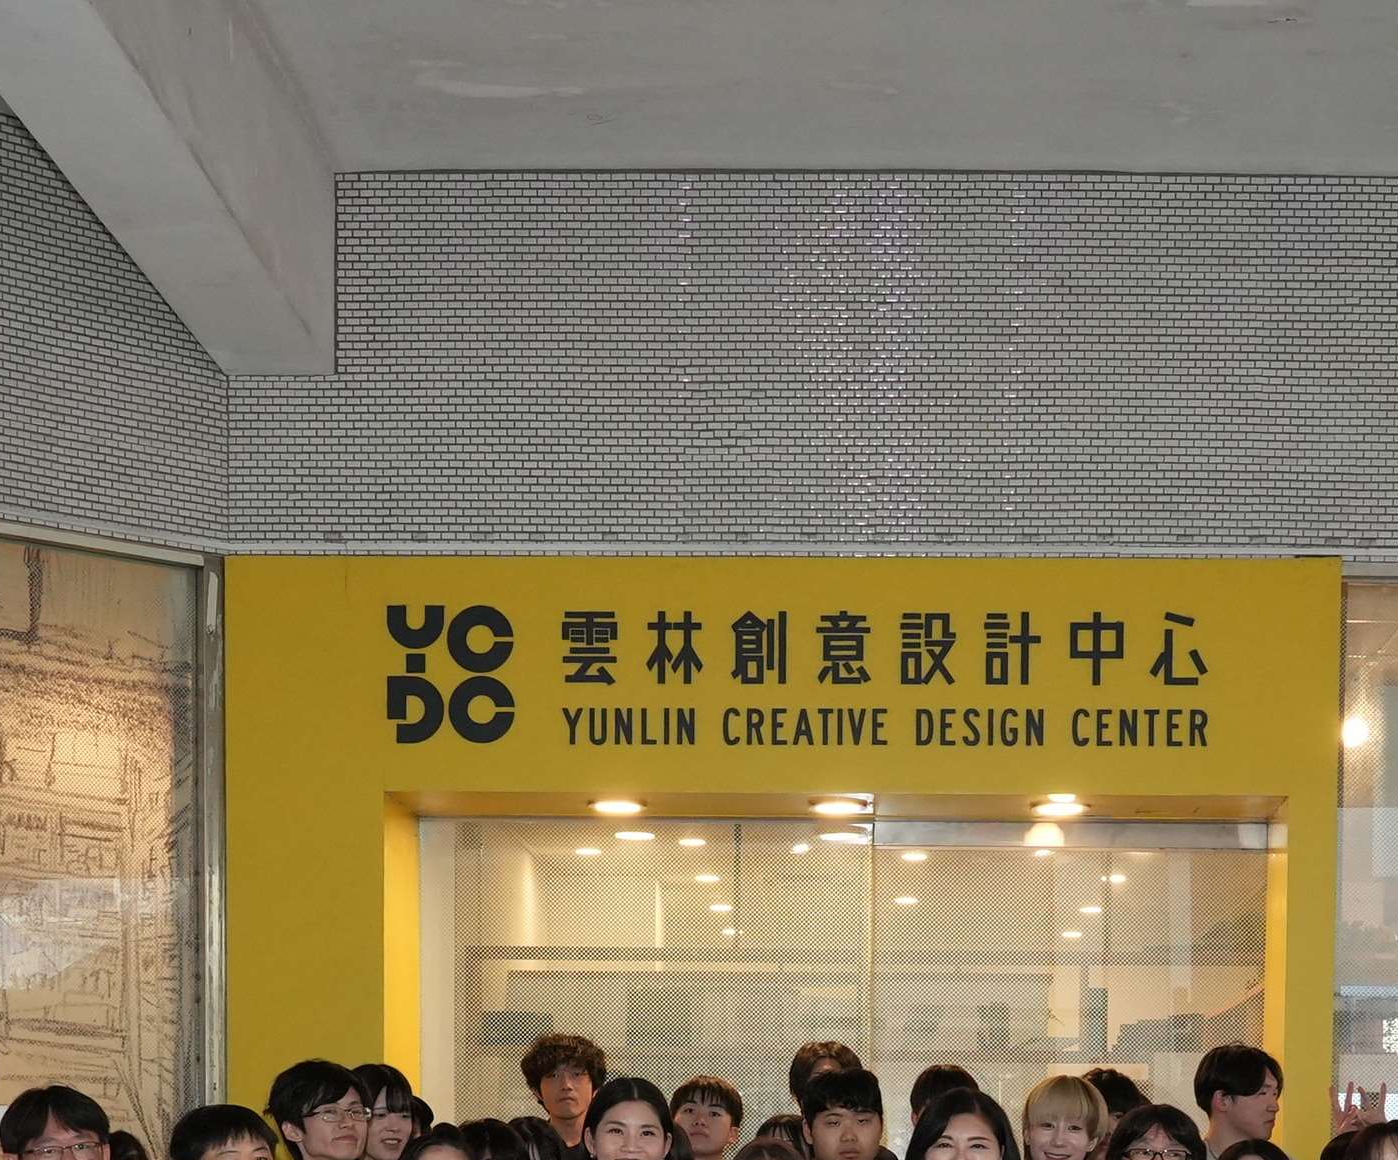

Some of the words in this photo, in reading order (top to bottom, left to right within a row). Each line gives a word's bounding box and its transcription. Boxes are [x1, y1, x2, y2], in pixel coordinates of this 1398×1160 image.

[562, 611, 1210, 687] 雲林創意設計中心
[563, 708, 697, 747] YUNLIN
[723, 708, 889, 747] CREATIVE
[916, 708, 1046, 748] DESIGN
[1072, 709, 1210, 748] CENTER
